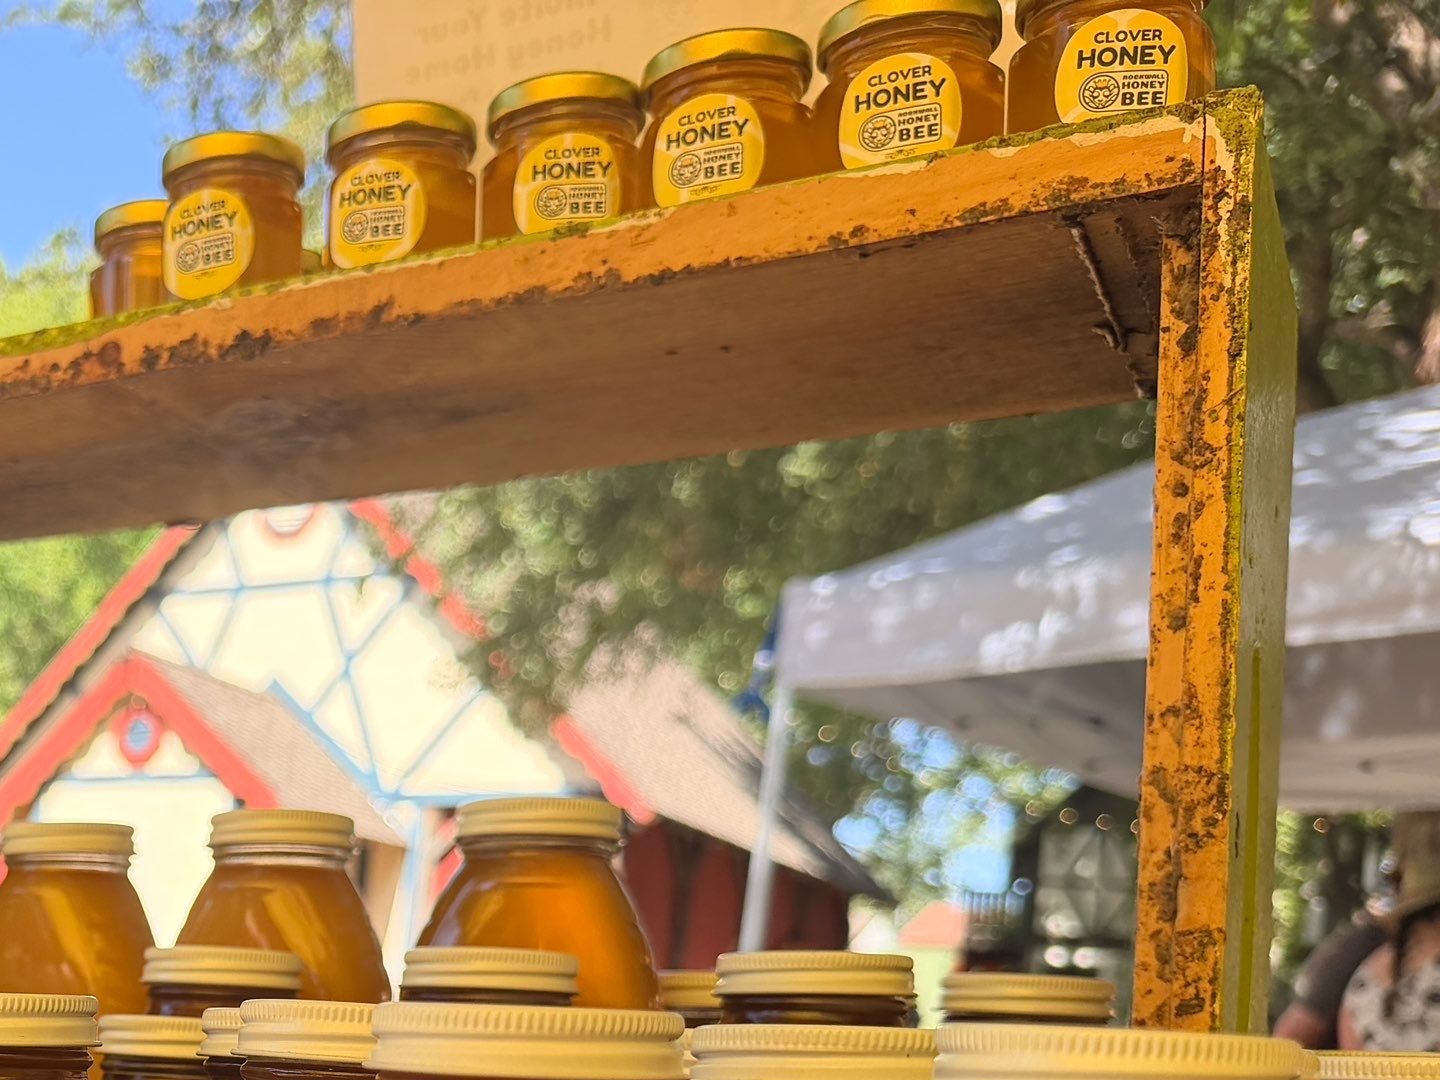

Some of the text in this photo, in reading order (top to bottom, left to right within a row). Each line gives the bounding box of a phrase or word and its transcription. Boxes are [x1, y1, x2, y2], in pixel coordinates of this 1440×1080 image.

[1094, 29, 1162, 44] CLOVER
[1077, 44, 1176, 69] HONEY
[867, 65, 932, 88] CLOVER
[1122, 81, 1165, 89] HONEY
[855, 78, 946, 113] HONEY
[1121, 91, 1164, 106] BEE
[678, 106, 736, 127] CLOVER
[898, 113, 939, 127] HONEY
[666, 119, 749, 152] HONEY
[899, 123, 939, 142] BEE
[544, 147, 600, 160] CLOVER
[703, 152, 740, 164] HONEY
[351, 171, 400, 186] CLOVER
[532, 161, 612, 181] HONEY
[704, 162, 740, 179] BEE
[339, 184, 411, 208] HONEY
[570, 201, 604, 214] BEE
[172, 211, 238, 240] HONEY
[371, 224, 402, 237] BEE
